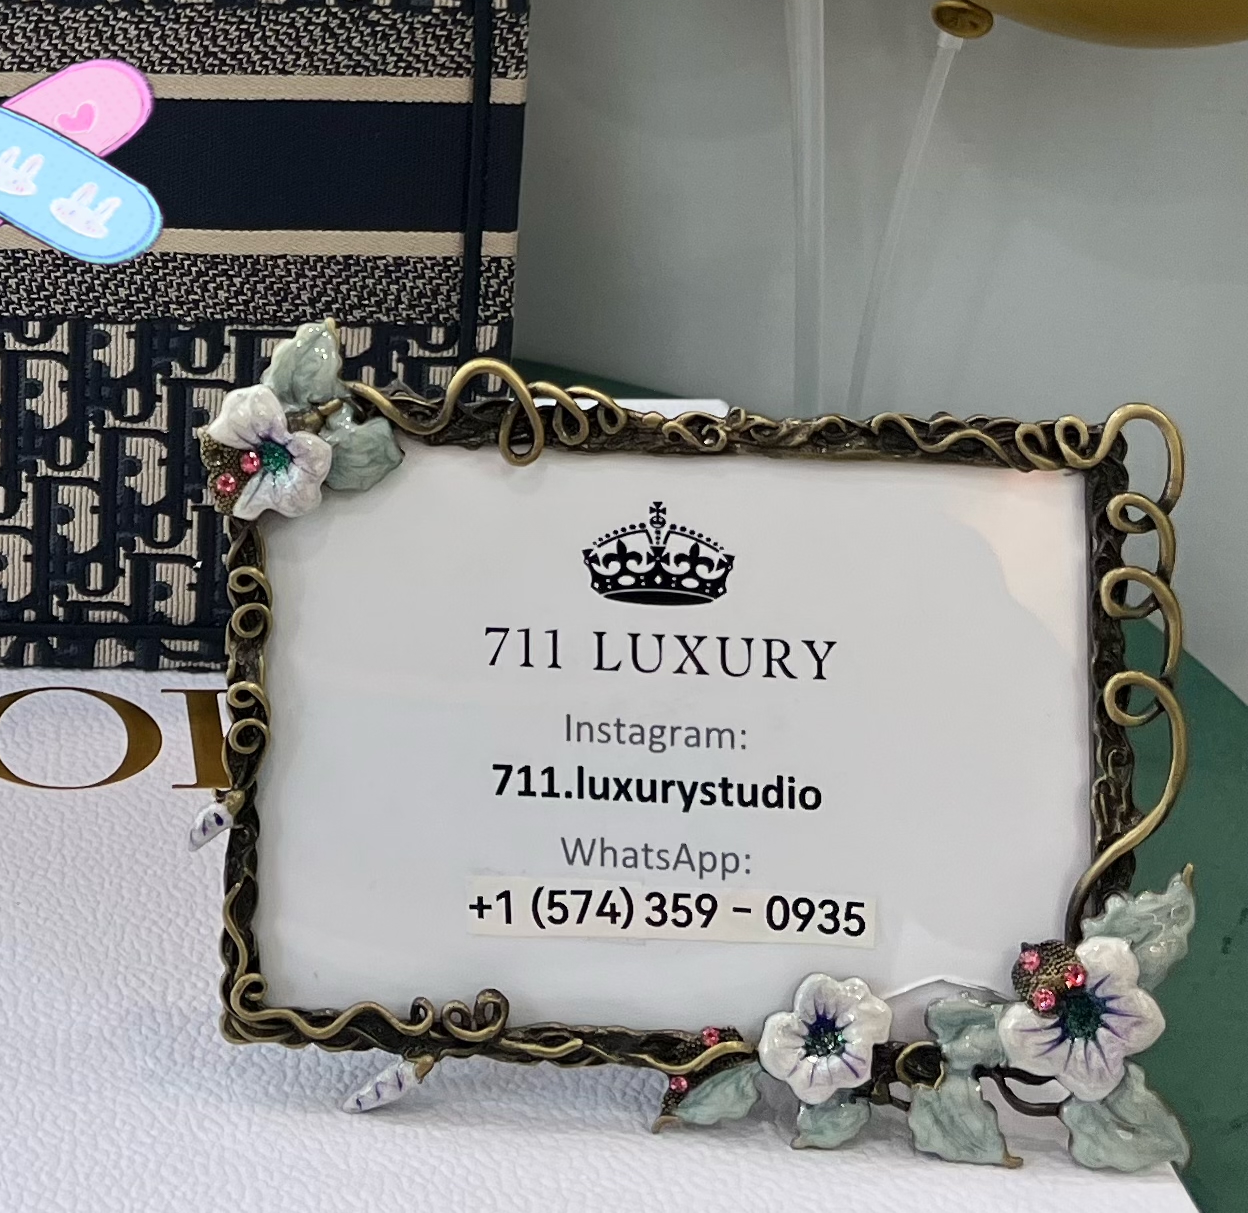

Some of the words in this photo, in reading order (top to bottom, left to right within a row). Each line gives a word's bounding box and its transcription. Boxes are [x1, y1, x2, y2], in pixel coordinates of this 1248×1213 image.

[484, 626, 562, 670] 711
[592, 630, 838, 681] LUXURY
[565, 713, 747, 754] Instagram:
[492, 763, 823, 813] 711.luxurystudio
[560, 836, 751, 881] WhatsApp:
[469, 889, 512, 925] +1
[765, 895, 867, 937] 0935
